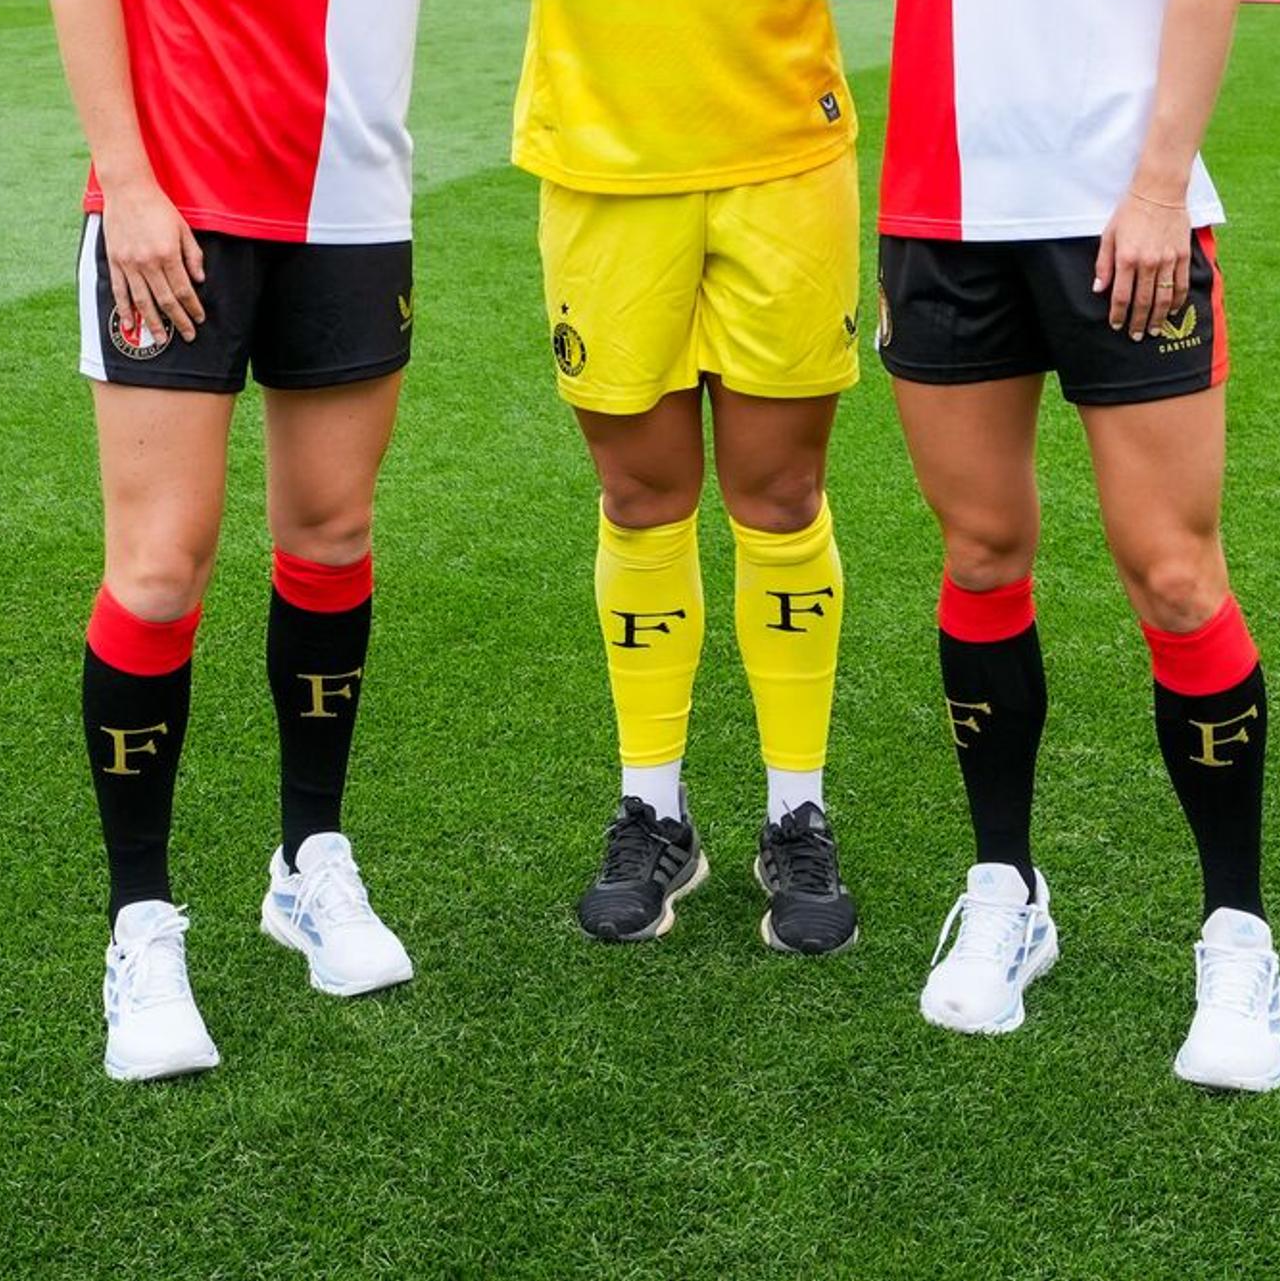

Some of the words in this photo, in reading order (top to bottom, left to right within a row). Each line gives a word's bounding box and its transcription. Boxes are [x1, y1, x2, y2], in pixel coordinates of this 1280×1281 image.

[611, 609, 687, 649] F
[765, 587, 834, 633] F
[297, 667, 362, 718] F
[100, 722, 168, 776] F
[1188, 704, 1258, 767] F
